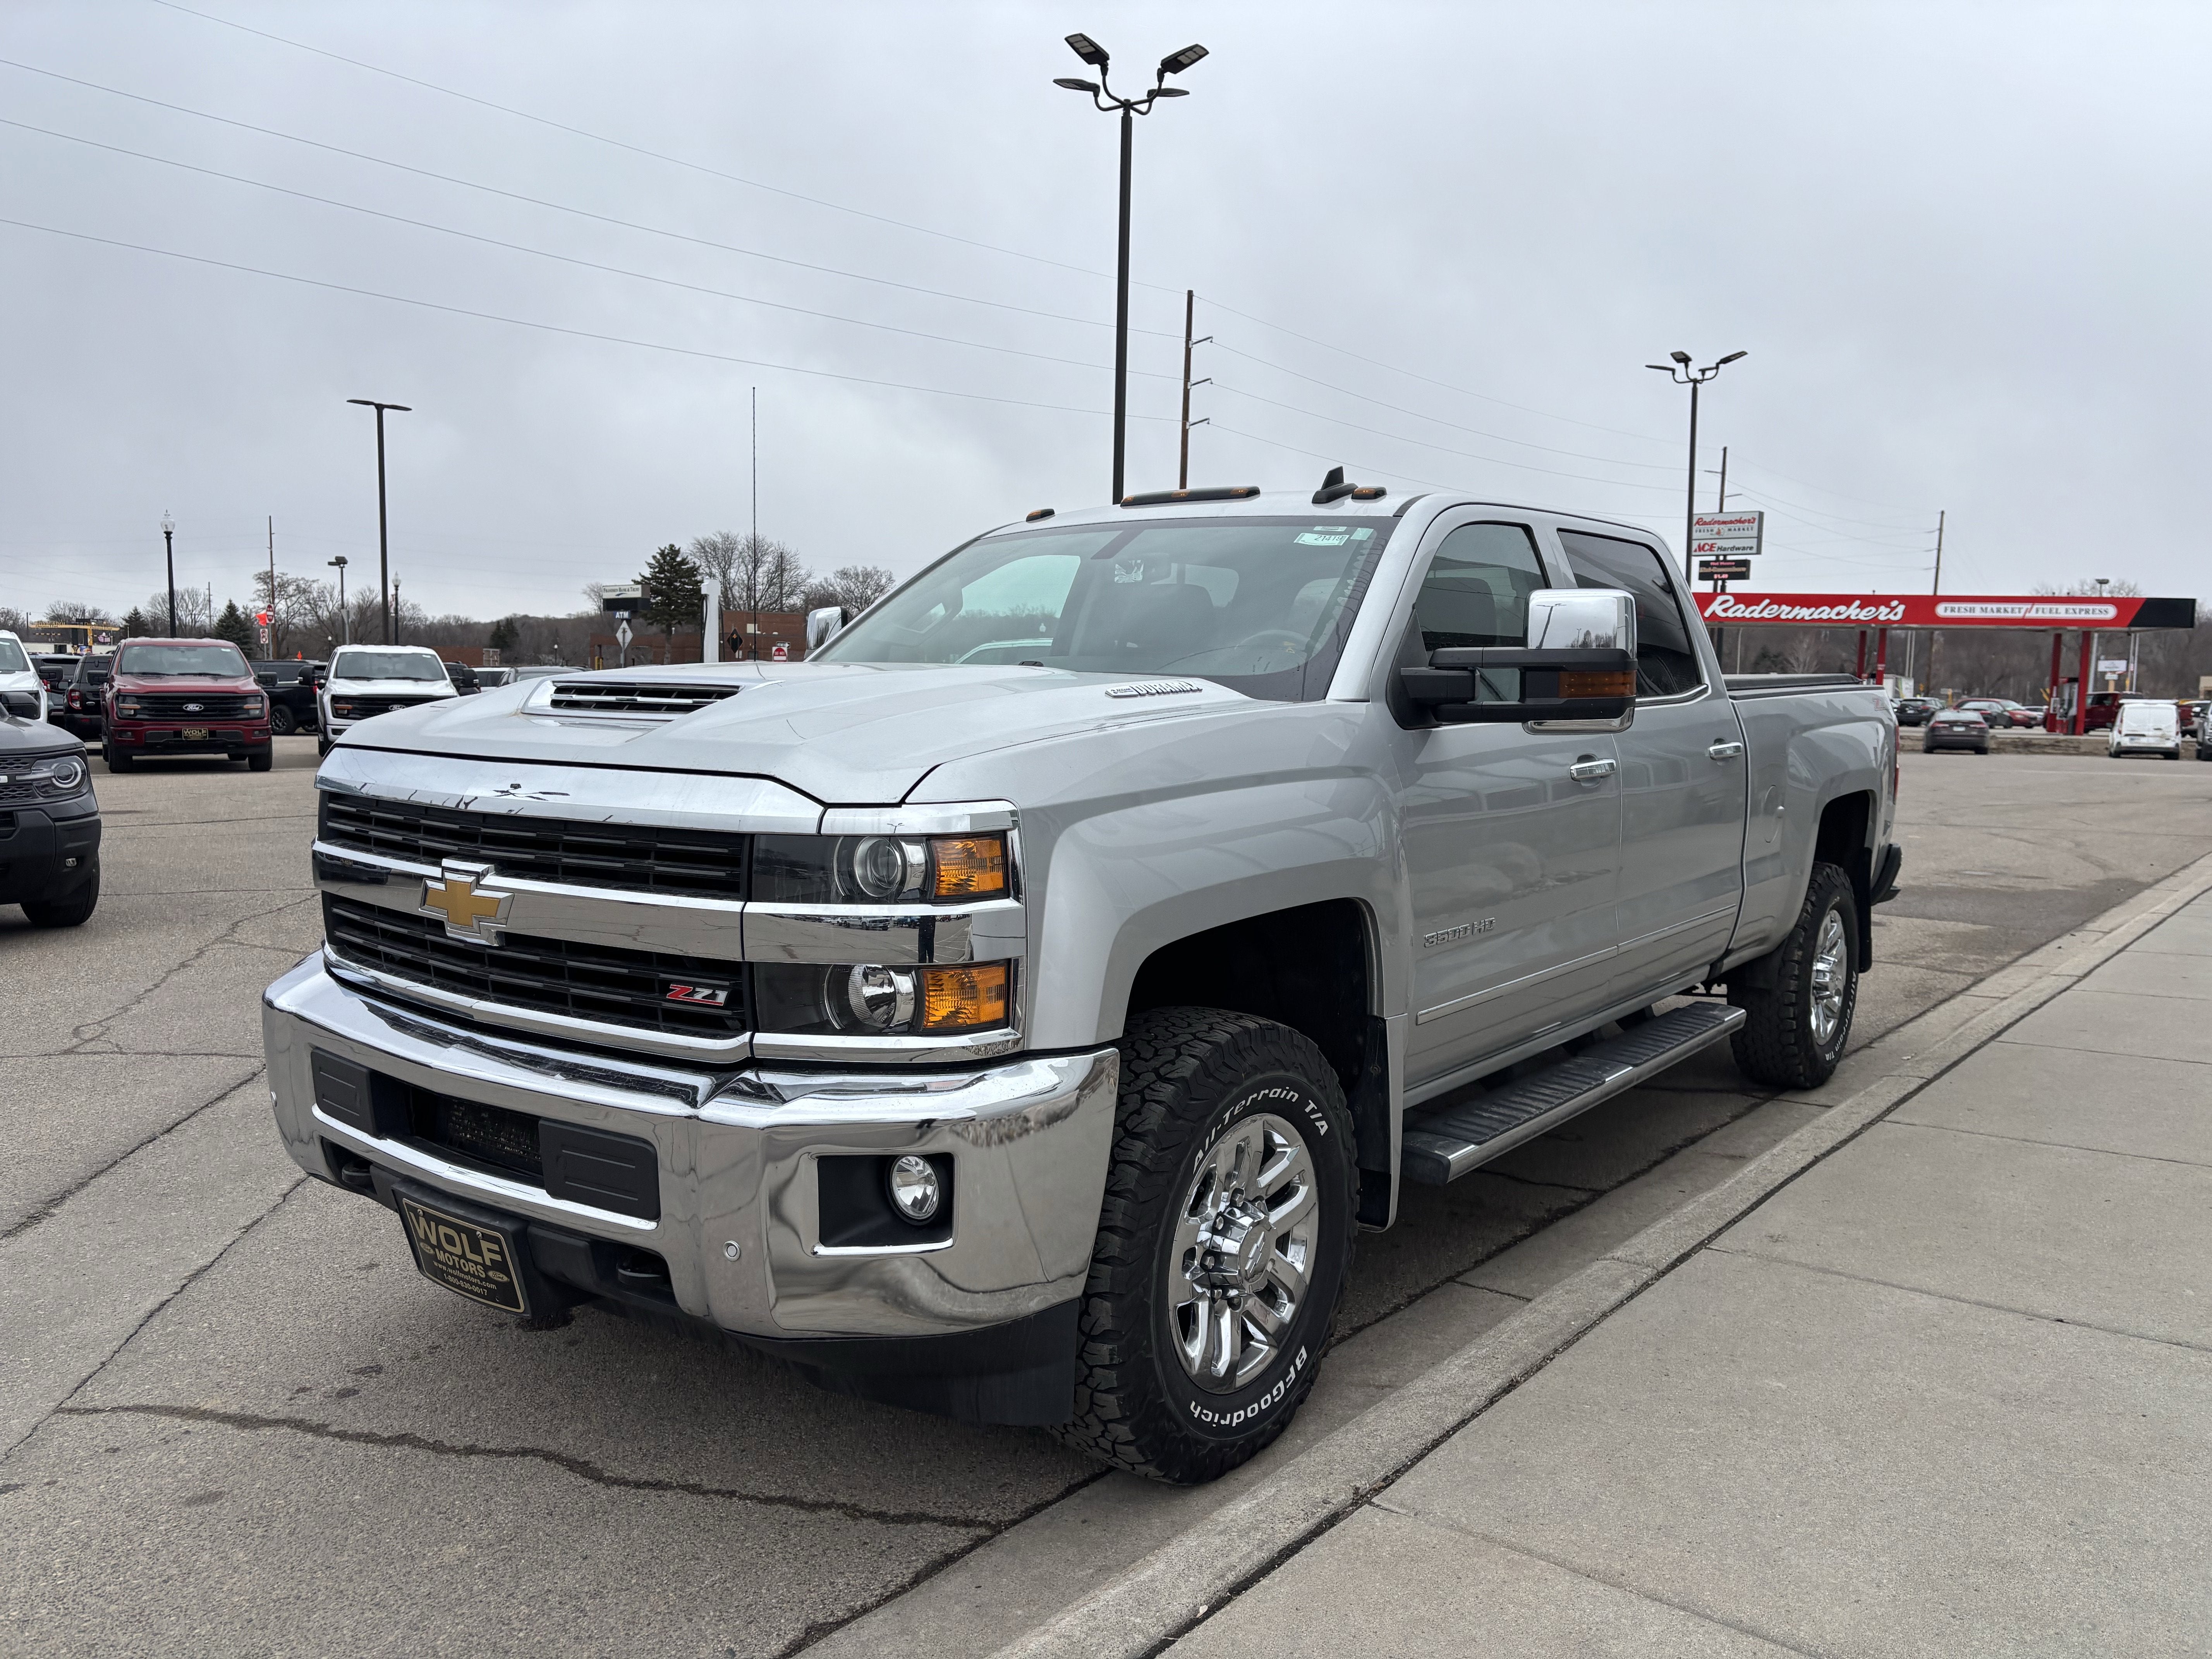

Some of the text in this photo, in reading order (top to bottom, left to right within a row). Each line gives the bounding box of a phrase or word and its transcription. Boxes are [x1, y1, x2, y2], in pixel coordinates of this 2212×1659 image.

[1694, 517, 1756, 526] Radermacher's
[1693, 543, 1717, 552] ACE
[1704, 595, 1906, 620] Radermacher's
[666, 984, 728, 1006] Z71
[1193, 1087, 1299, 1175] All-Terrain
[409, 1211, 502, 1266] WOLF
[435, 1248, 486, 1278] MOTORS
[444, 1273, 487, 1295] 1-800-830-0017
[1190, 1345, 1307, 1427] BFGoodrich
